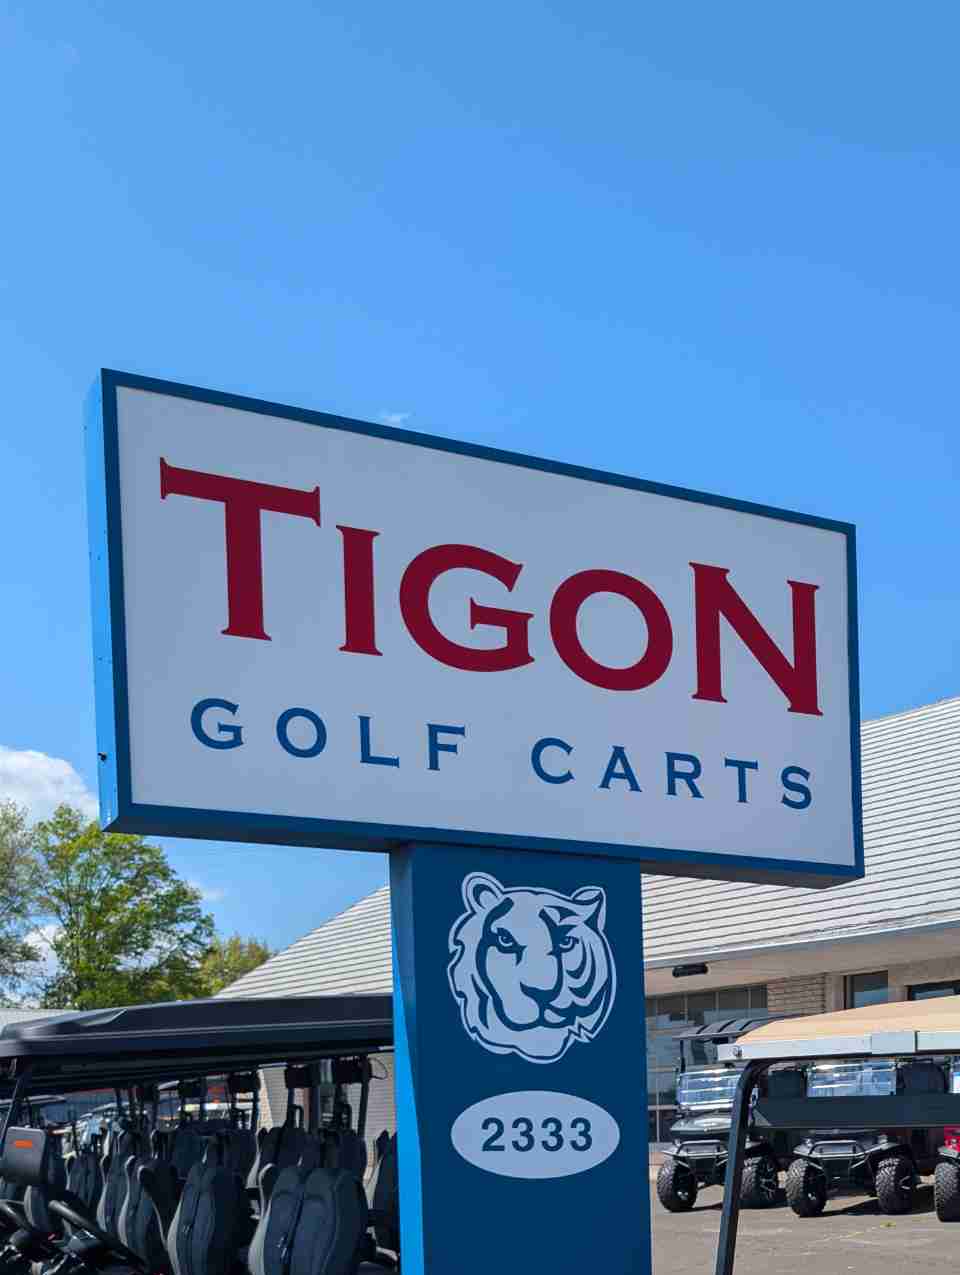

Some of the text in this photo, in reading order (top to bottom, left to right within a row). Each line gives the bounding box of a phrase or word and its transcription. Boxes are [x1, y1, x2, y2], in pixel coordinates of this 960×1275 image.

[160, 457, 823, 717] TIGON
[190, 697, 813, 810] GOLF CARTS
[481, 1117, 593, 1152] 2333
